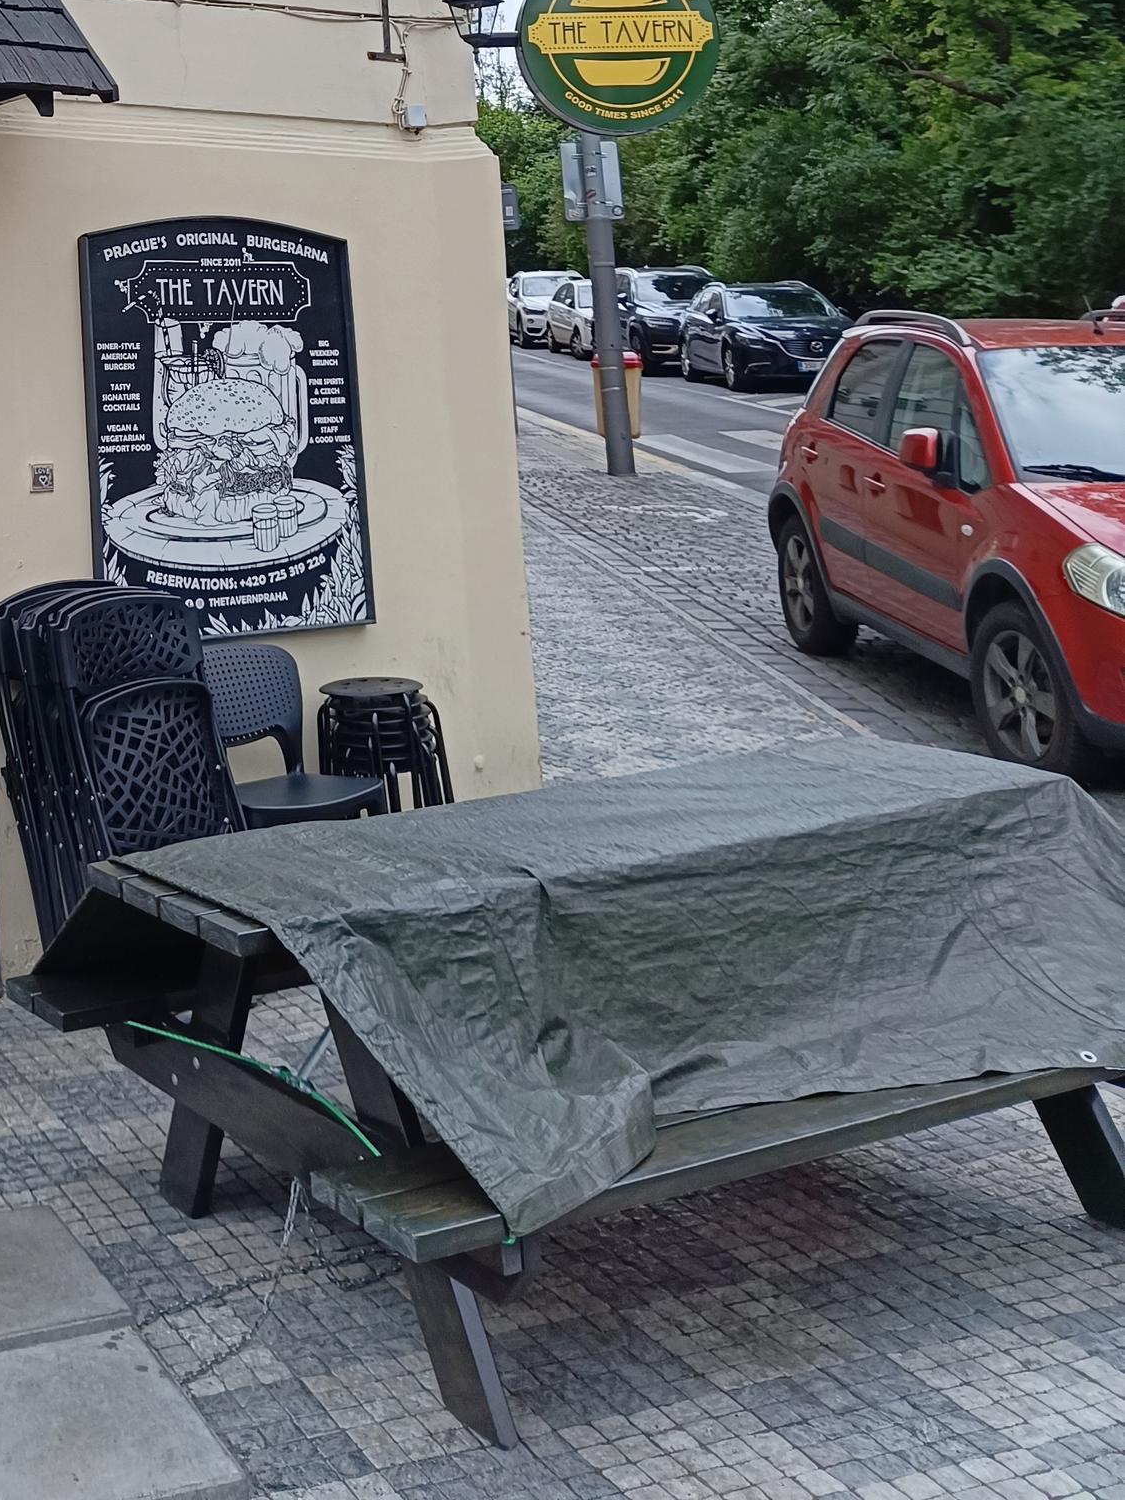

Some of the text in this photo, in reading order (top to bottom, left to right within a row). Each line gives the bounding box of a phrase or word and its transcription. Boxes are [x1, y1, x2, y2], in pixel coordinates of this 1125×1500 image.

[548, 20, 693, 44] THE TAVERN
[565, 88, 685, 119] GOOD TIMES SINCE 2011
[103, 232, 329, 264] PRAGUE'S ORIGINAL BURGERÁRNA
[200, 258, 241, 267] SINCE 2011
[156, 278, 284, 305] THE TAVERN
[110, 383, 131, 391] TASTY
[102, 393, 140, 401] SIGNATURE
[314, 416, 344, 424] FRIENDLY
[107, 424, 131, 432] VEGAN
[101, 434, 145, 442] VEGETARIAN
[147, 553, 326, 590] RESERVATIONS: +420 725 319 226
[208, 591, 288, 608] THETAVERNPRAHA
